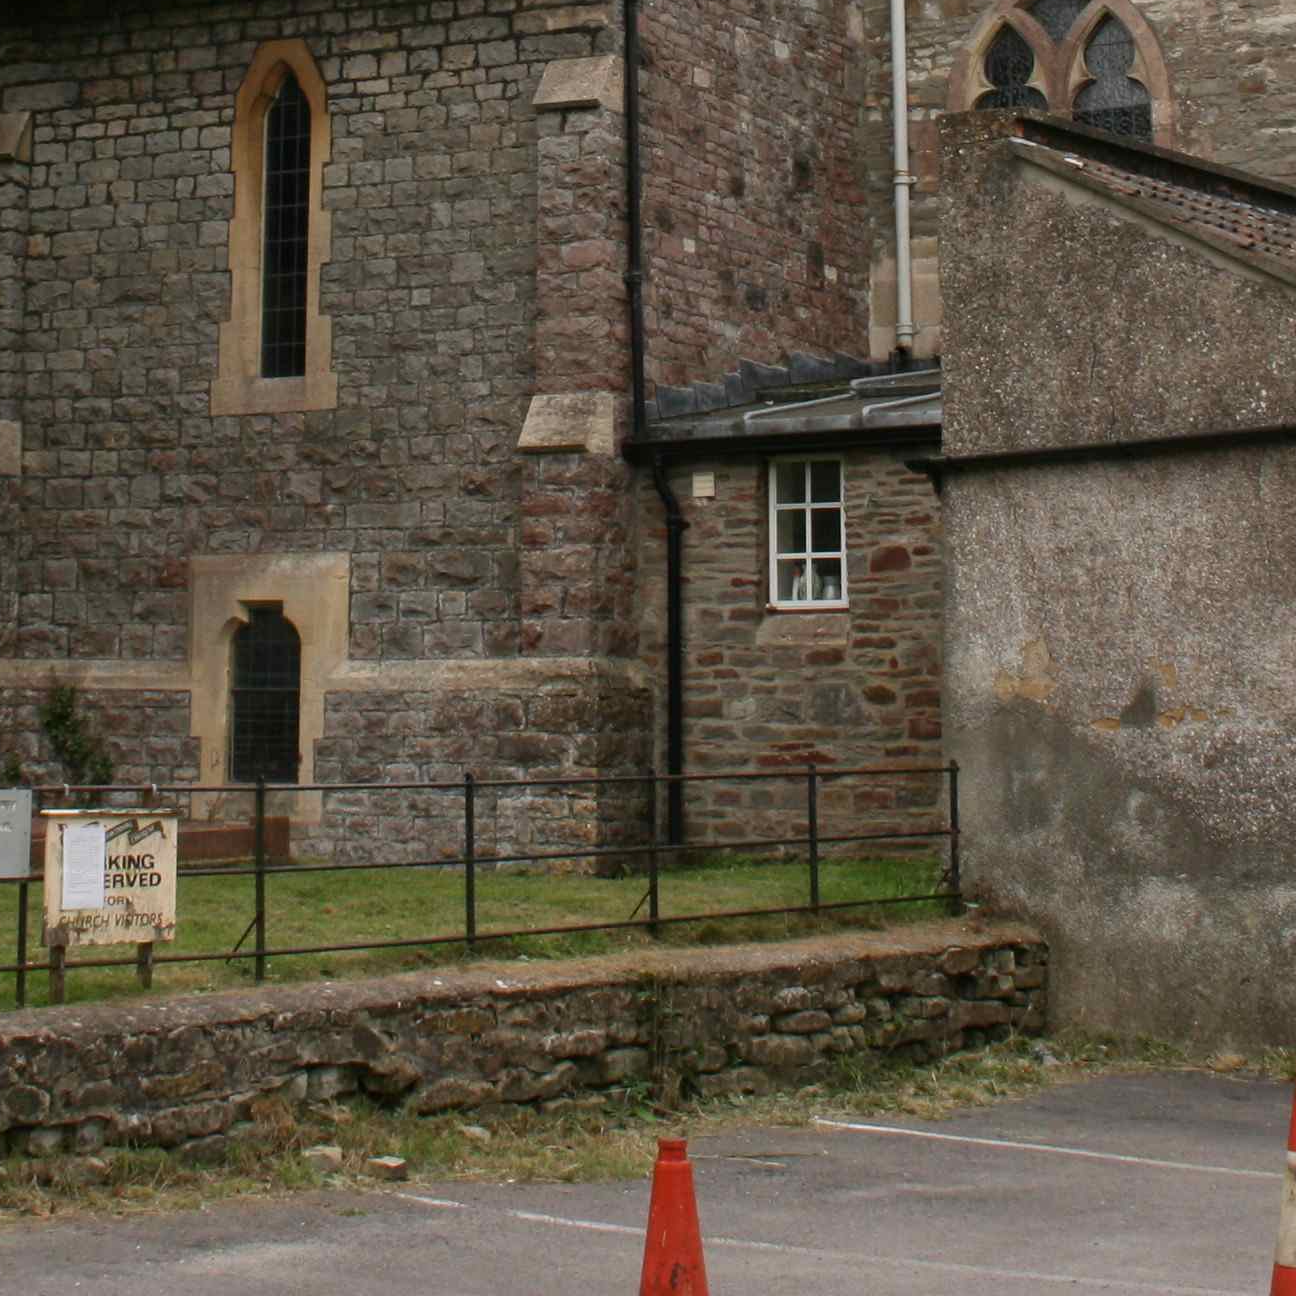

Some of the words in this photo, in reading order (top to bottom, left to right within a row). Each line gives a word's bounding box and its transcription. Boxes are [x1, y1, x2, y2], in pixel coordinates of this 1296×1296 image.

[103, 854, 156, 870] KING
[103, 873, 162, 889] ERVED
[59, 915, 110, 929] CHURCH
[115, 912, 163, 927] VISITORS
